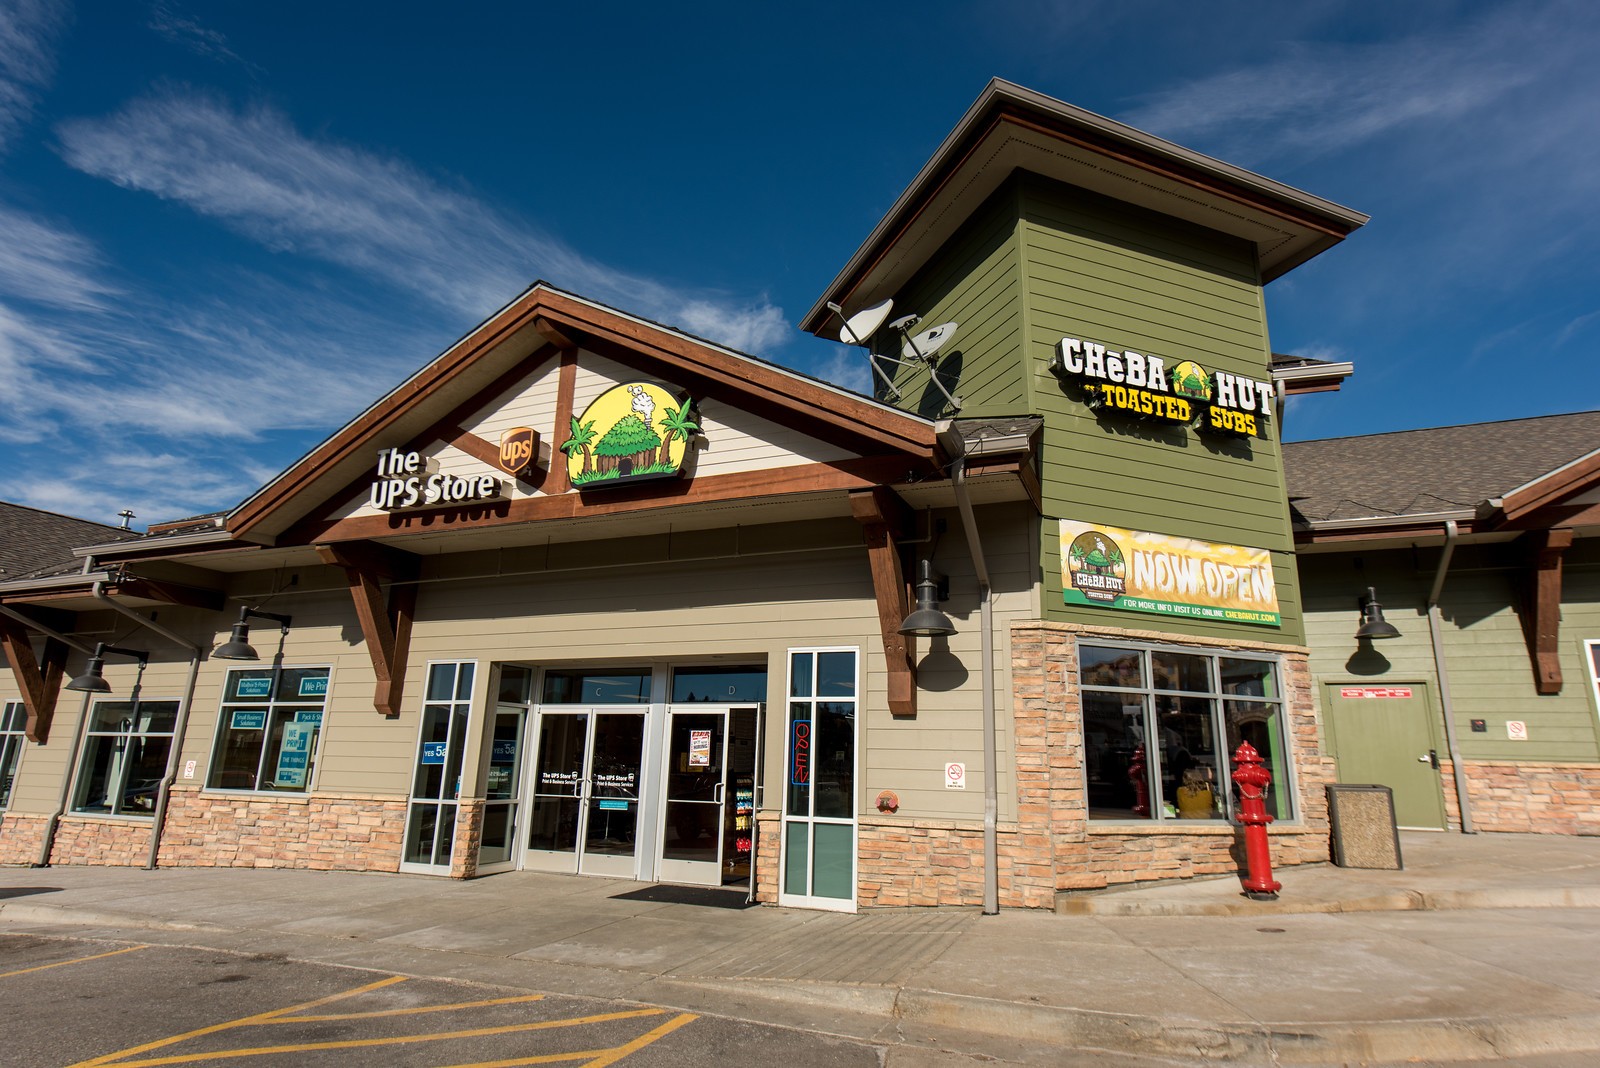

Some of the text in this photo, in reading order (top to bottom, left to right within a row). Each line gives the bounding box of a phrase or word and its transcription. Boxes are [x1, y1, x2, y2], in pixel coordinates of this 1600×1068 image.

[1216, 371, 1274, 416] HUT
[1101, 384, 1257, 437] TOASTED SUBS
[377, 447, 420, 476] The
[502, 439, 530, 466] ups
[370, 474, 495, 510] UPS Store
[1105, 576, 1123, 590] HUT
[1133, 550, 1273, 603] NOW OPEN
[1123, 599, 1276, 622] FOR MORE INFO VISIT US ONLINE CHEBAHUT.COM
[305, 682, 315, 691] We
[728, 685, 736, 695] D
[288, 729, 297, 737] WE
[424, 749, 435, 757] YES
[794, 723, 810, 783] OPEN
